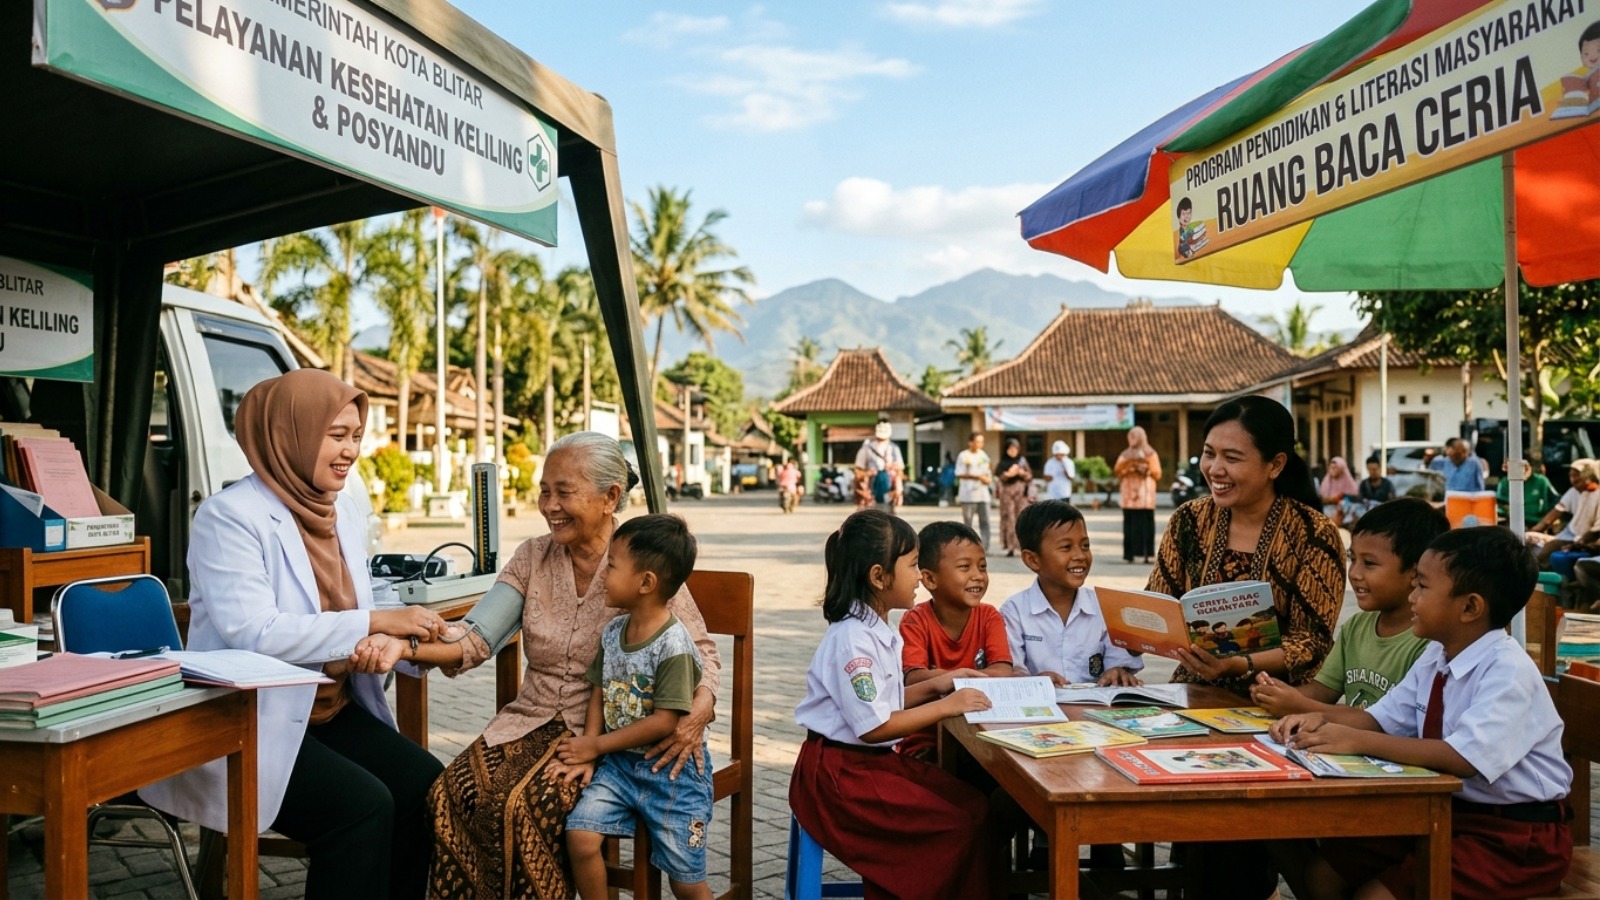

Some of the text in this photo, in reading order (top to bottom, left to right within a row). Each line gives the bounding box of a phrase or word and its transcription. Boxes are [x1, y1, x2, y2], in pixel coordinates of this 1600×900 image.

[331, 57, 449, 141] KESEHATAN
[454, 117, 523, 174] KELILING
[384, 35, 429, 82] KOTA
[432, 61, 483, 110] BLITAR
[1186, 143, 1244, 191] PROGRAM
[1246, 101, 1331, 164] PENDIDIKAN
[1335, 94, 1347, 123] &
[1350, 52, 1430, 116] LITERASI
[312, 95, 445, 176] & POSYANDU
[1217, 54, 1543, 233] RUANG BACA CERIA
[9, 306, 79, 335] KELILING
